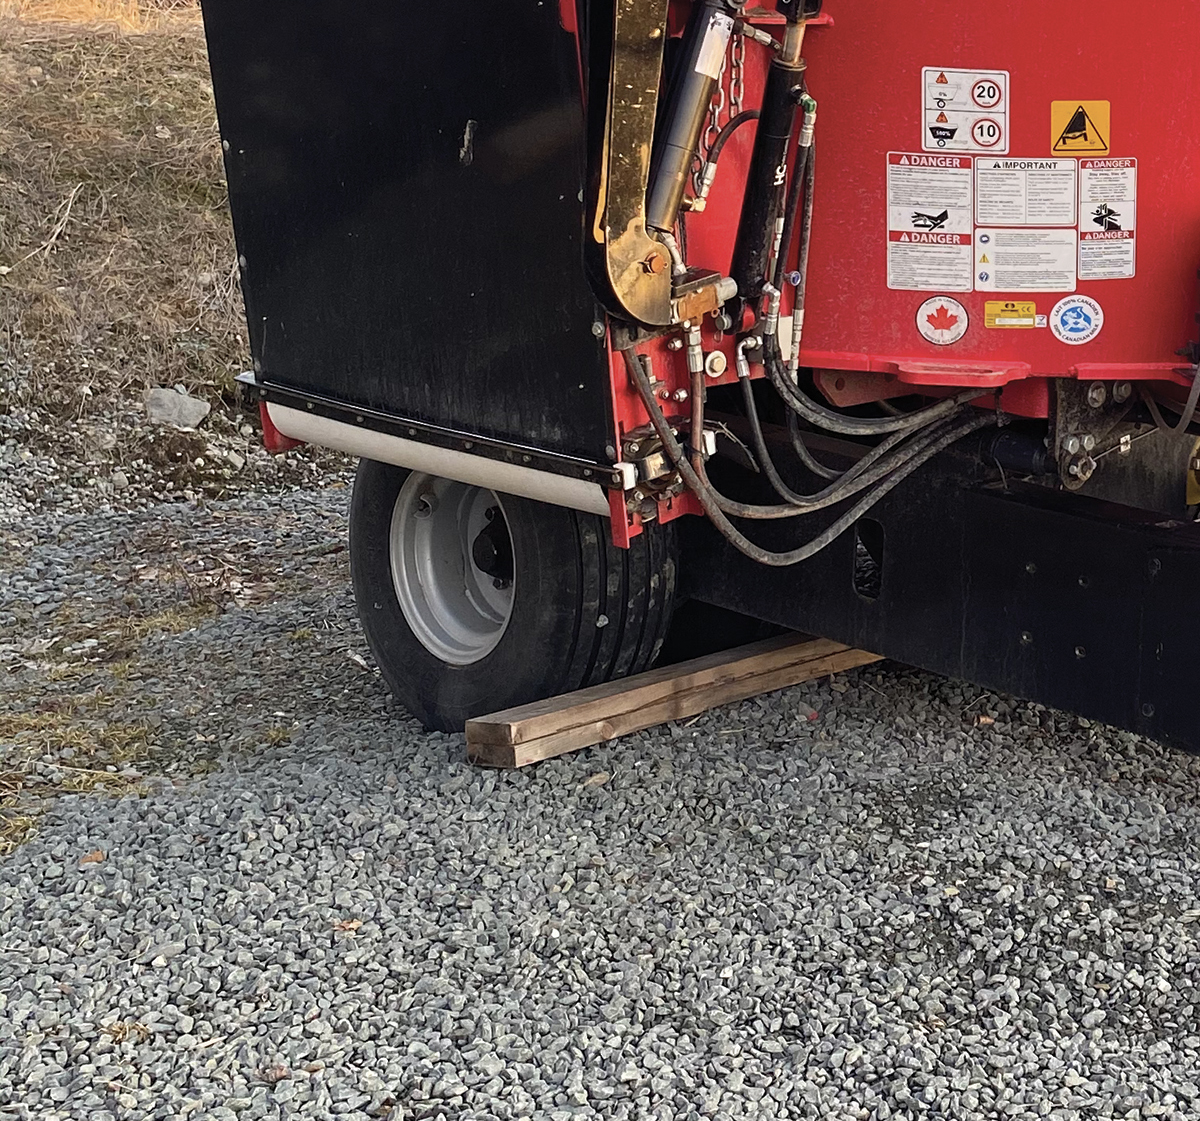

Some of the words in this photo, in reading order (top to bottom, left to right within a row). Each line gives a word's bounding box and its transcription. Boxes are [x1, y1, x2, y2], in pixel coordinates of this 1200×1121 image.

[976, 85, 996, 99] 20
[977, 124, 996, 138] 10
[911, 155, 960, 168] DANGER
[1002, 161, 1058, 170] IMPORTANT
[1093, 160, 1131, 168] DANGER
[911, 232, 960, 244] DANGER
[1092, 231, 1130, 240] DANGER
[1054, 305, 1063, 317] LAIT
[1077, 298, 1099, 316] CANADIEN
[1062, 333, 1091, 342] CANADIAN
